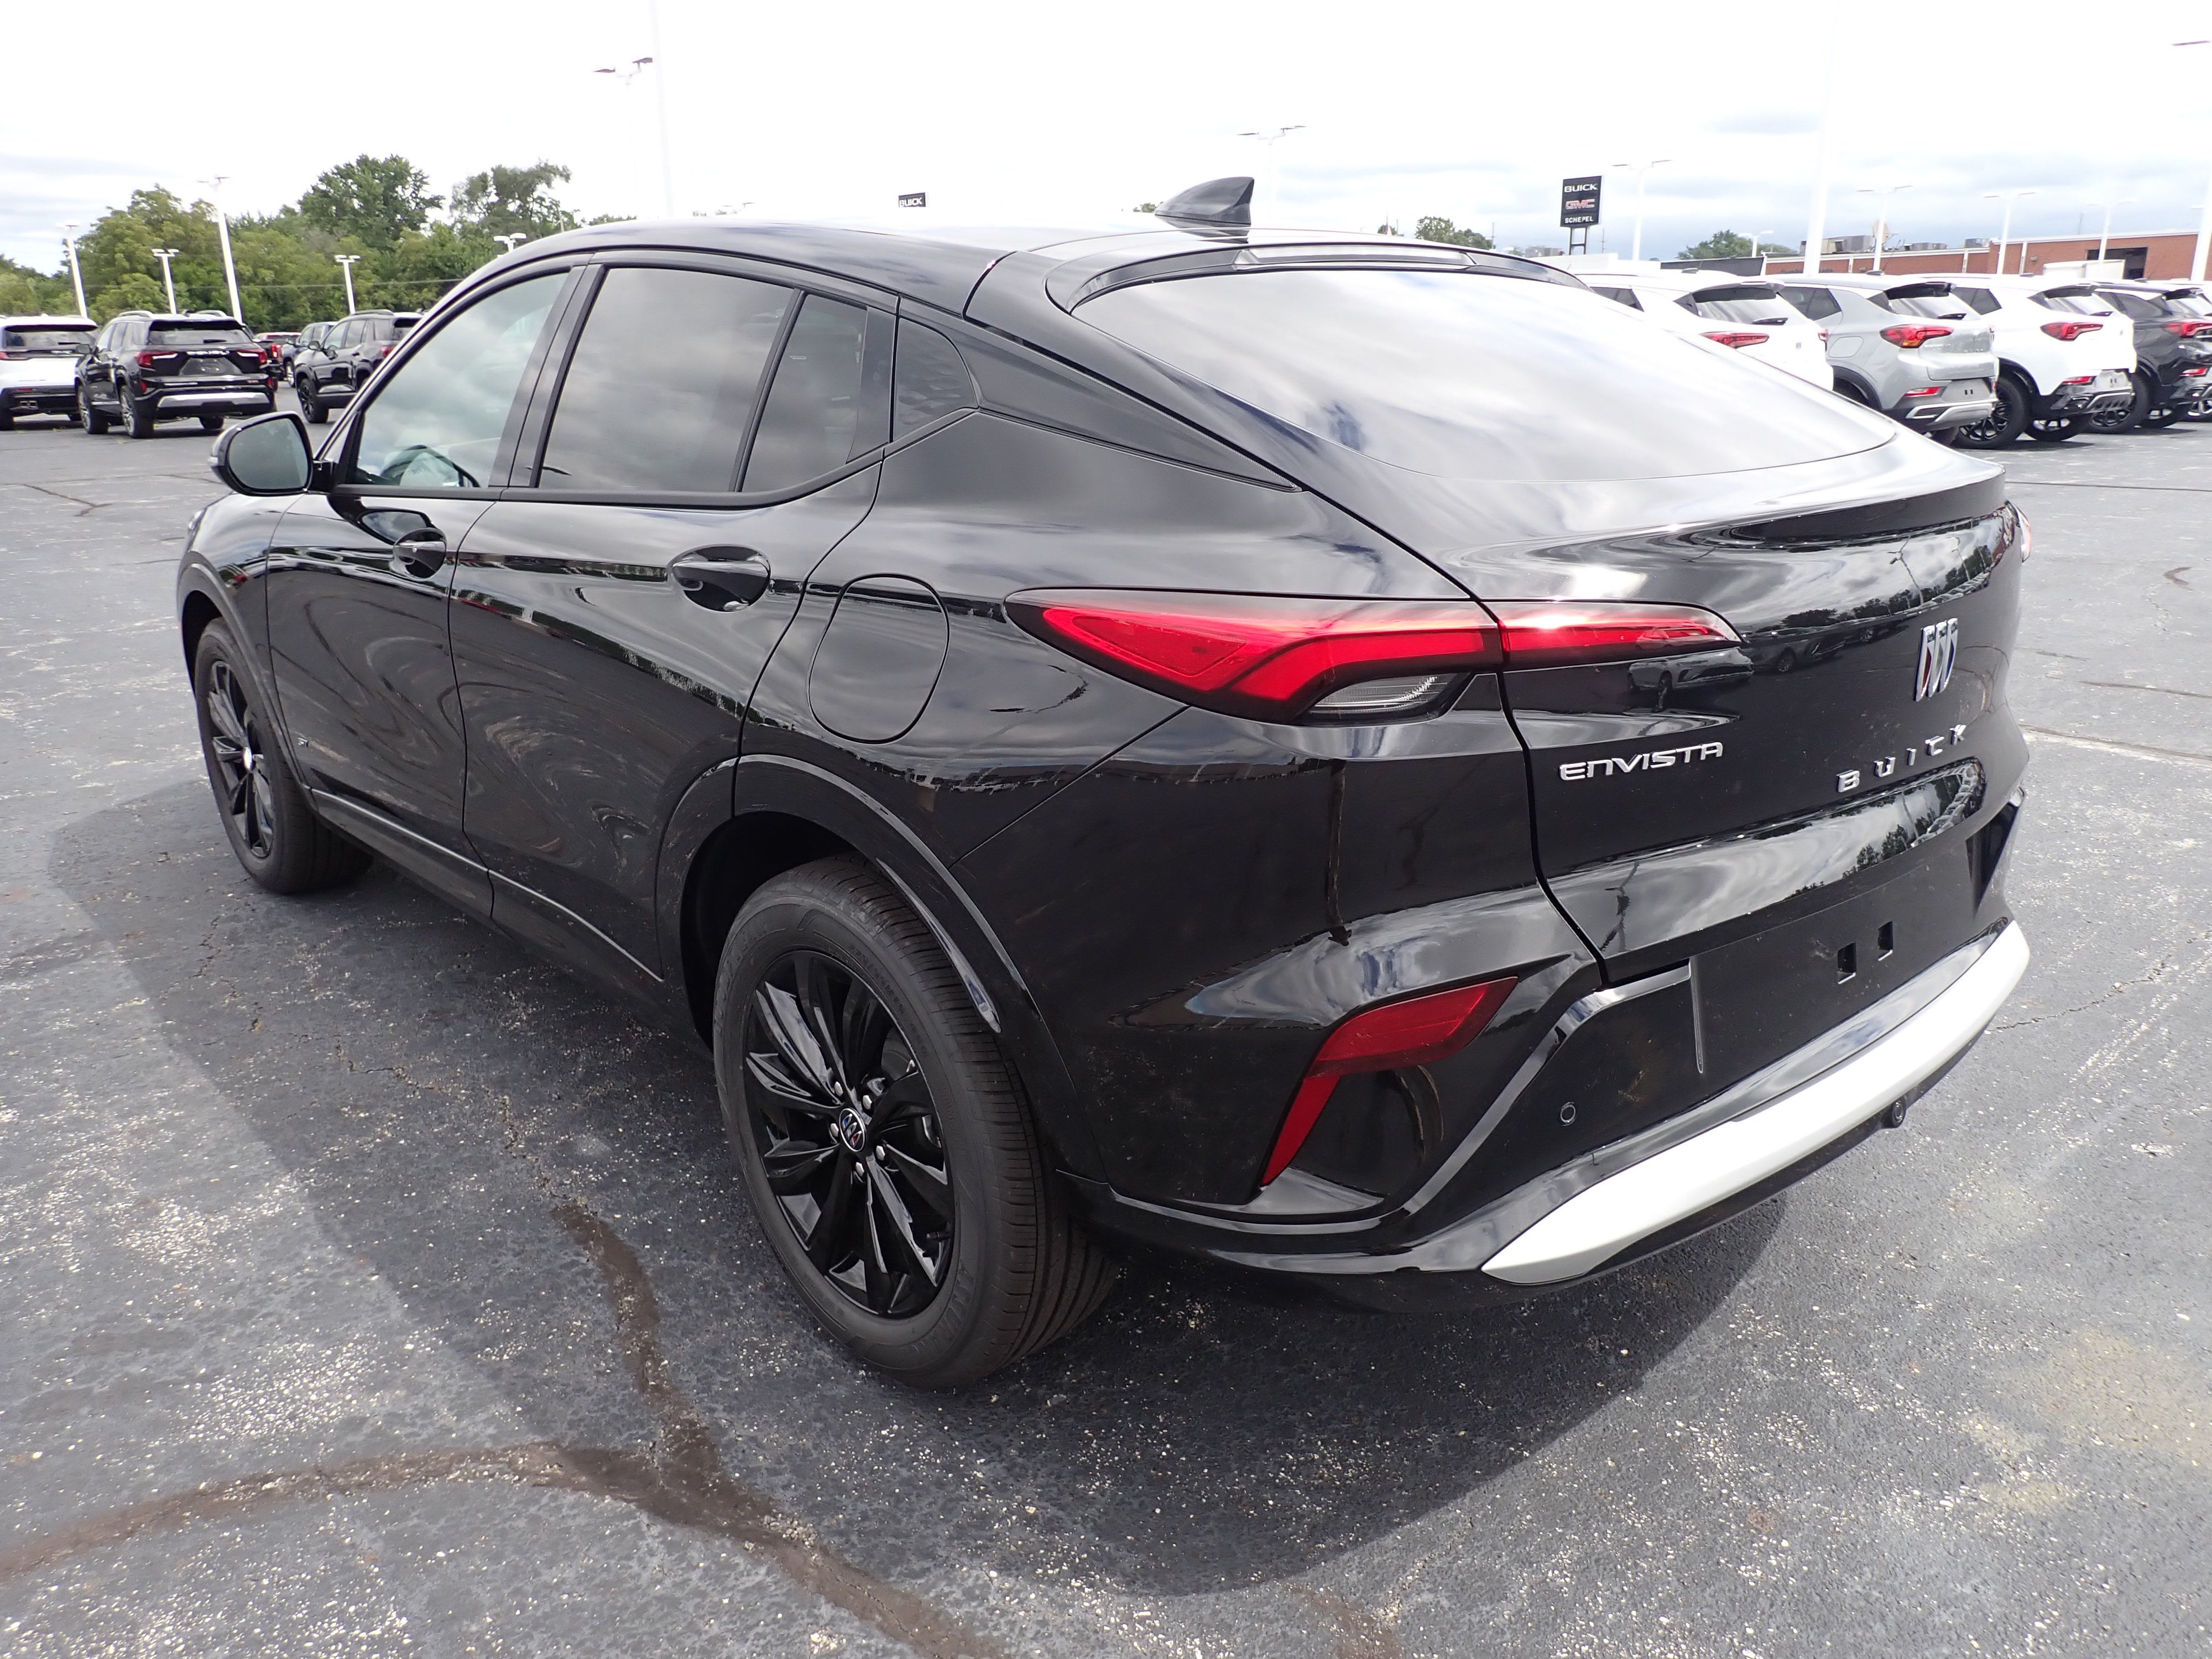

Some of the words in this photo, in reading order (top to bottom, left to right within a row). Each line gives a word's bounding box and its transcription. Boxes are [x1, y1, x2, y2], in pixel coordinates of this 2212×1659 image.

[1564, 184, 1598, 192] BUICK
[899, 197, 922, 208] BUICK
[1566, 199, 1595, 210] GMC
[1559, 741, 1724, 781] ENVISTA
[1836, 724, 1966, 793] BUICK
